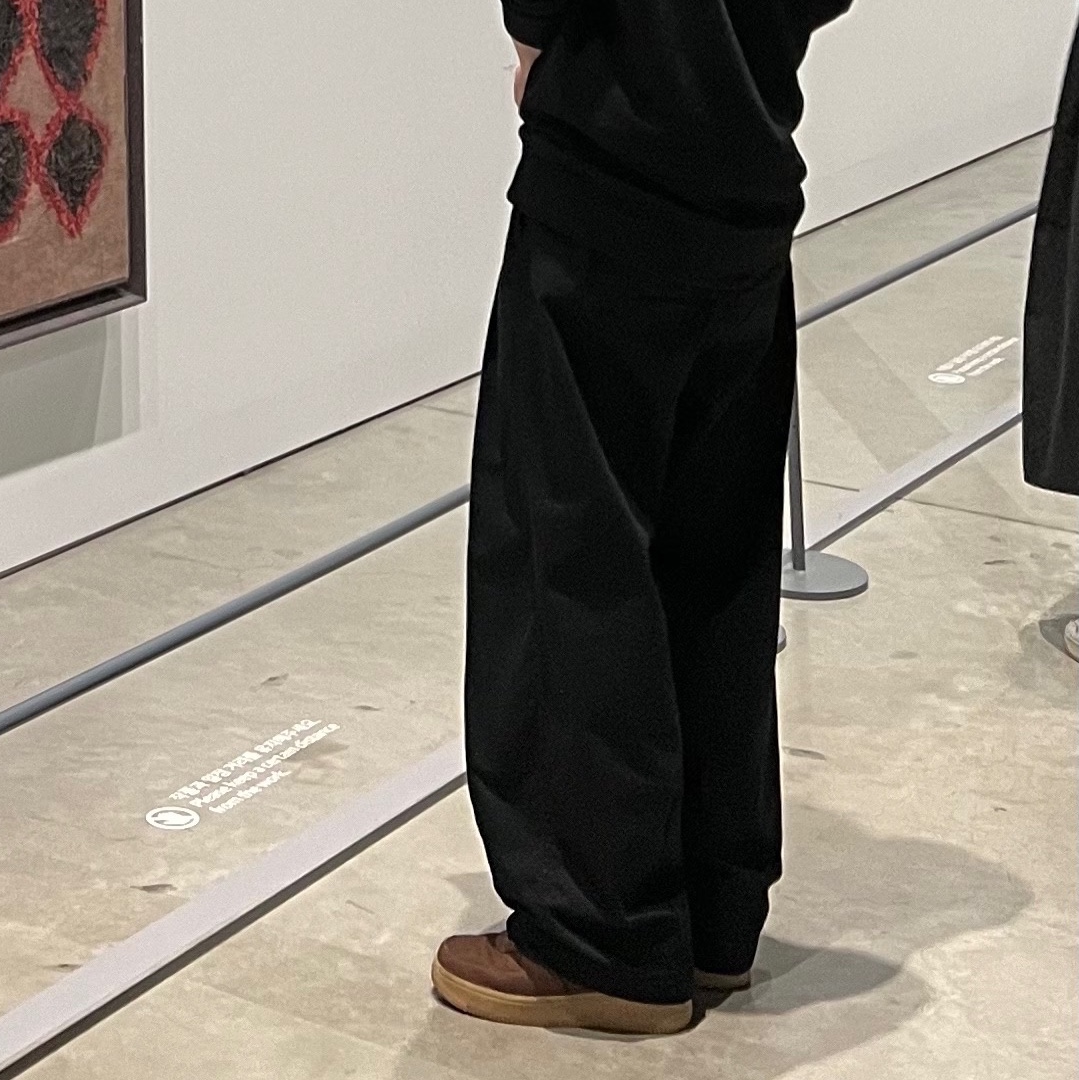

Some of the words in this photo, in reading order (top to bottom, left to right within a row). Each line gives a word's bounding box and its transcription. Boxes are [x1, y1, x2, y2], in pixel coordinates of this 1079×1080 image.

[188, 785, 233, 808] Please
[221, 770, 259, 788] keep
[252, 765, 266, 773] a
[208, 796, 245, 814] from
[235, 785, 263, 799] the
